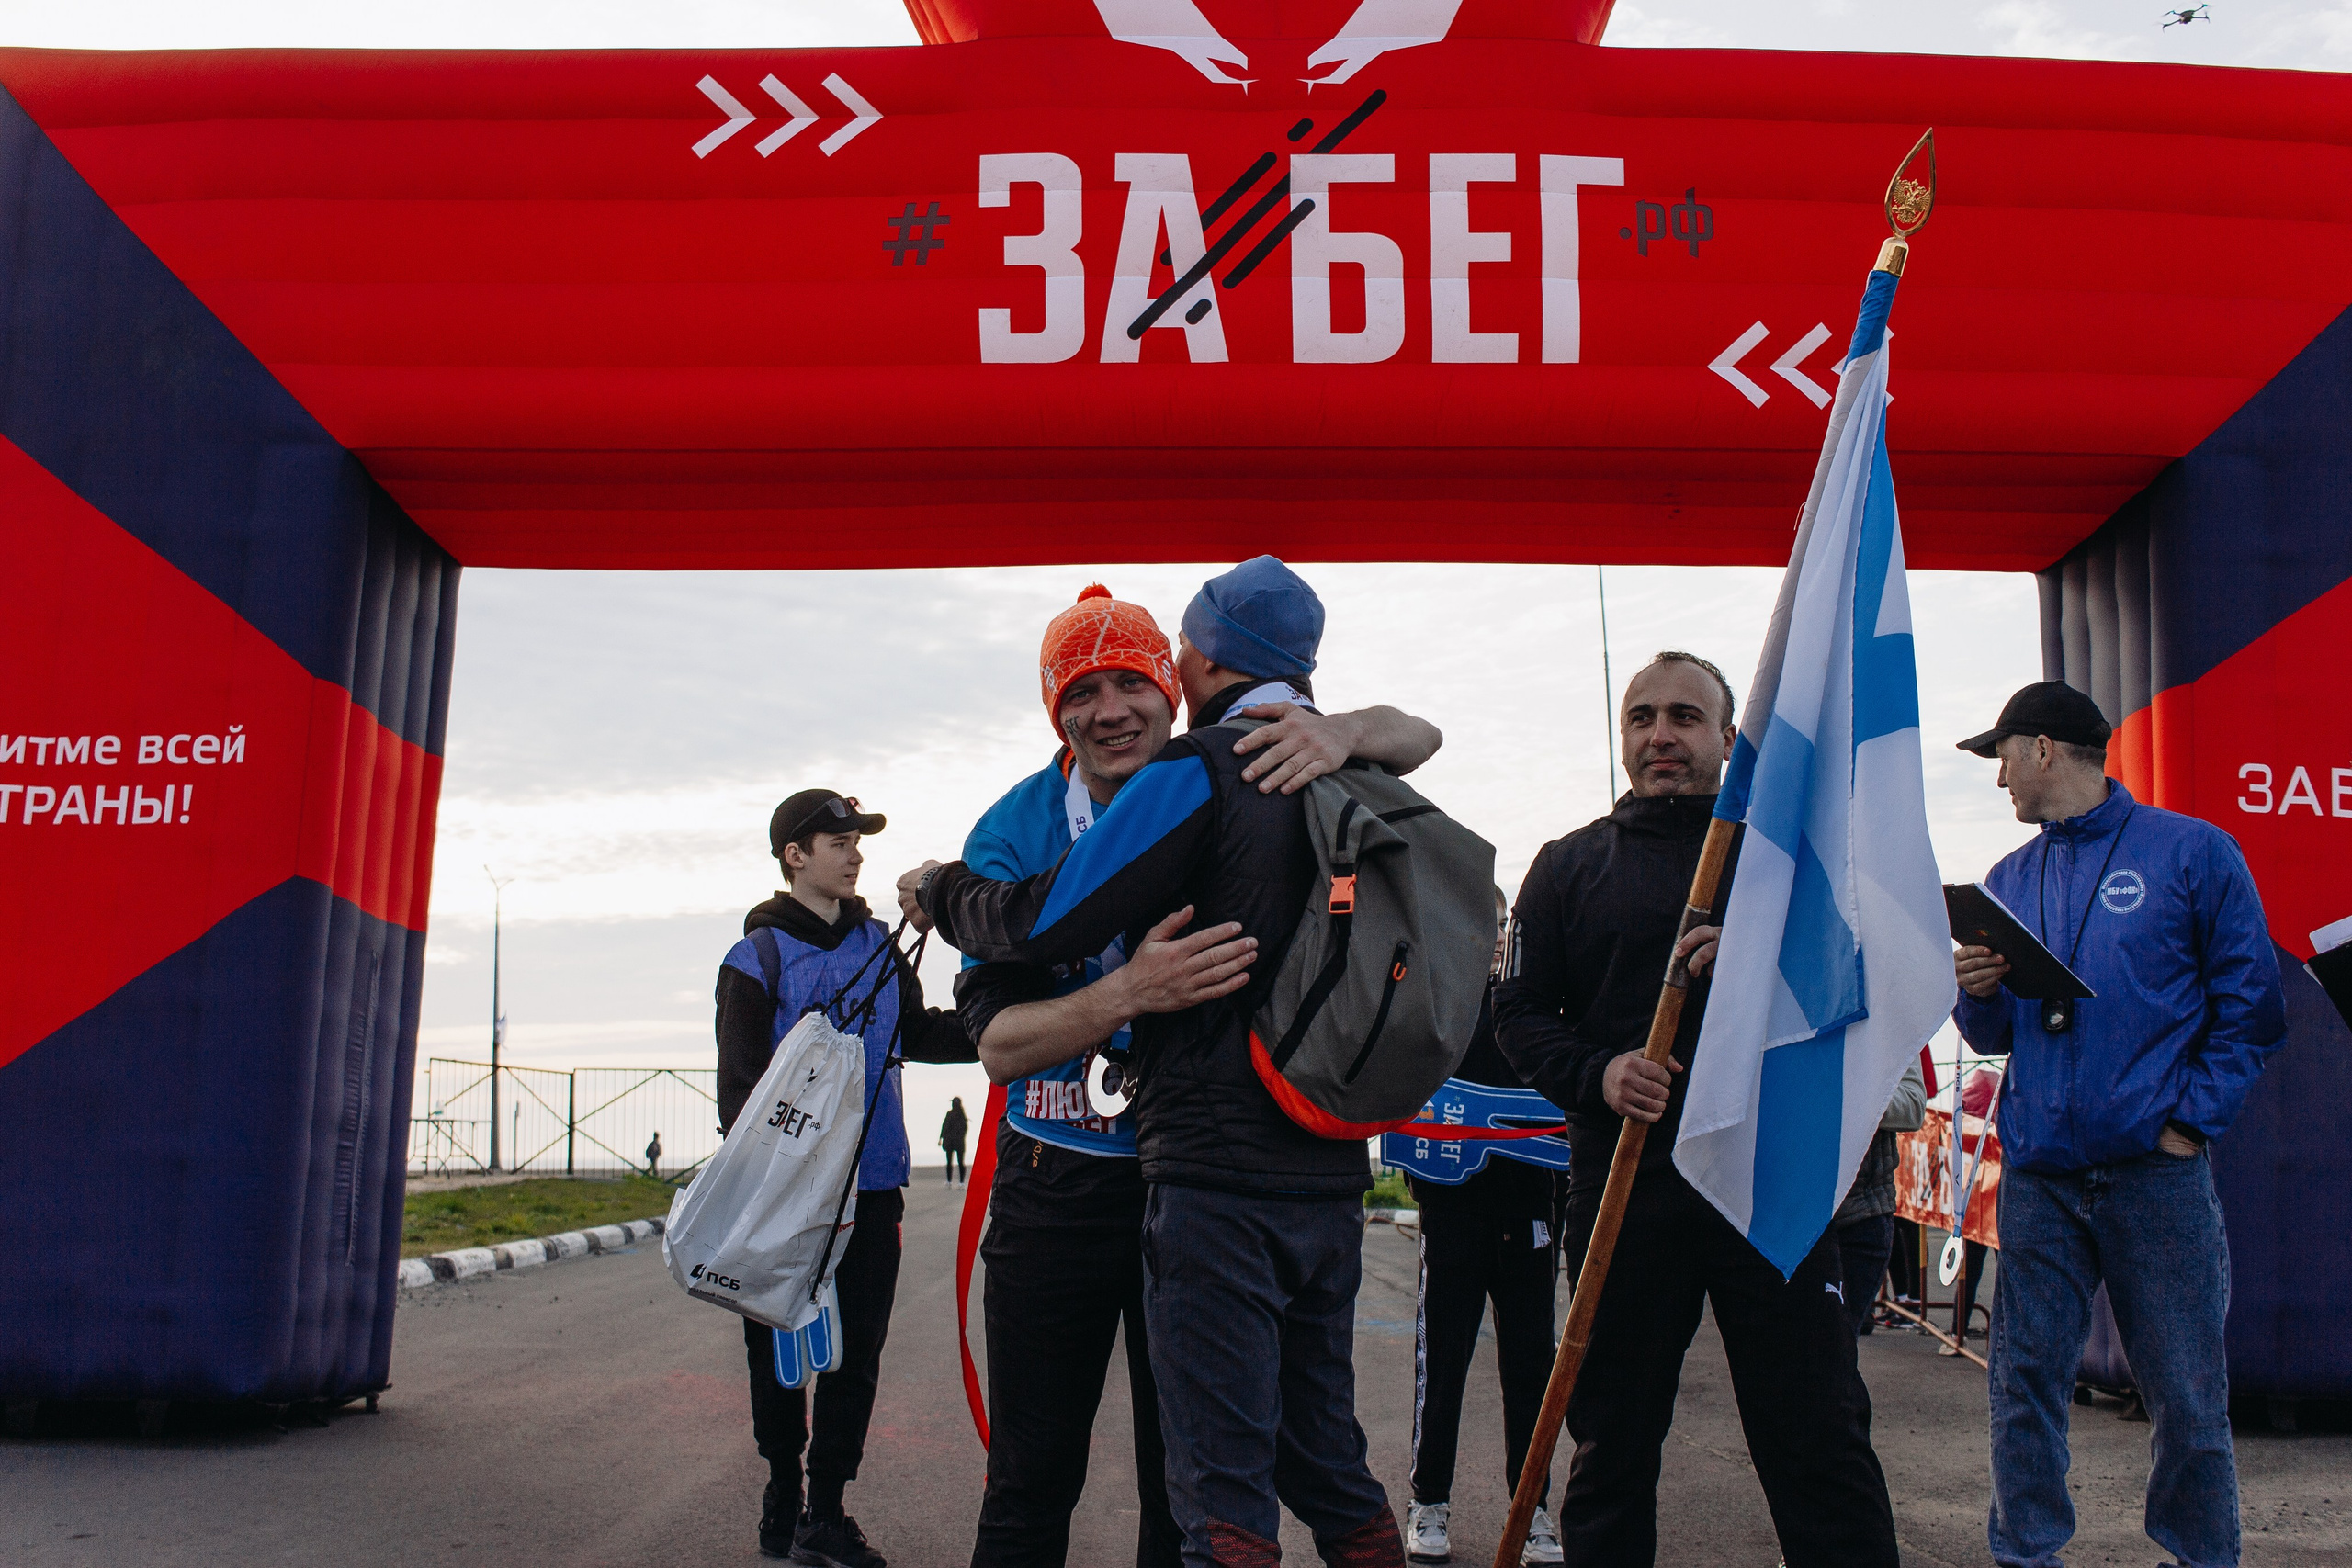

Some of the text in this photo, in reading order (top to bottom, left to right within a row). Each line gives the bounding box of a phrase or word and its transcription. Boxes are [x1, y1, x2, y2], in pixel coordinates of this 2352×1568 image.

[0, 723, 247, 766] итме всей
[0, 784, 194, 825] ТРАНЫ!
[1075, 815, 1088, 834] СБ
[1415, 1137, 1430, 1160] СБ
[707, 1271, 741, 1291] ПСБ
